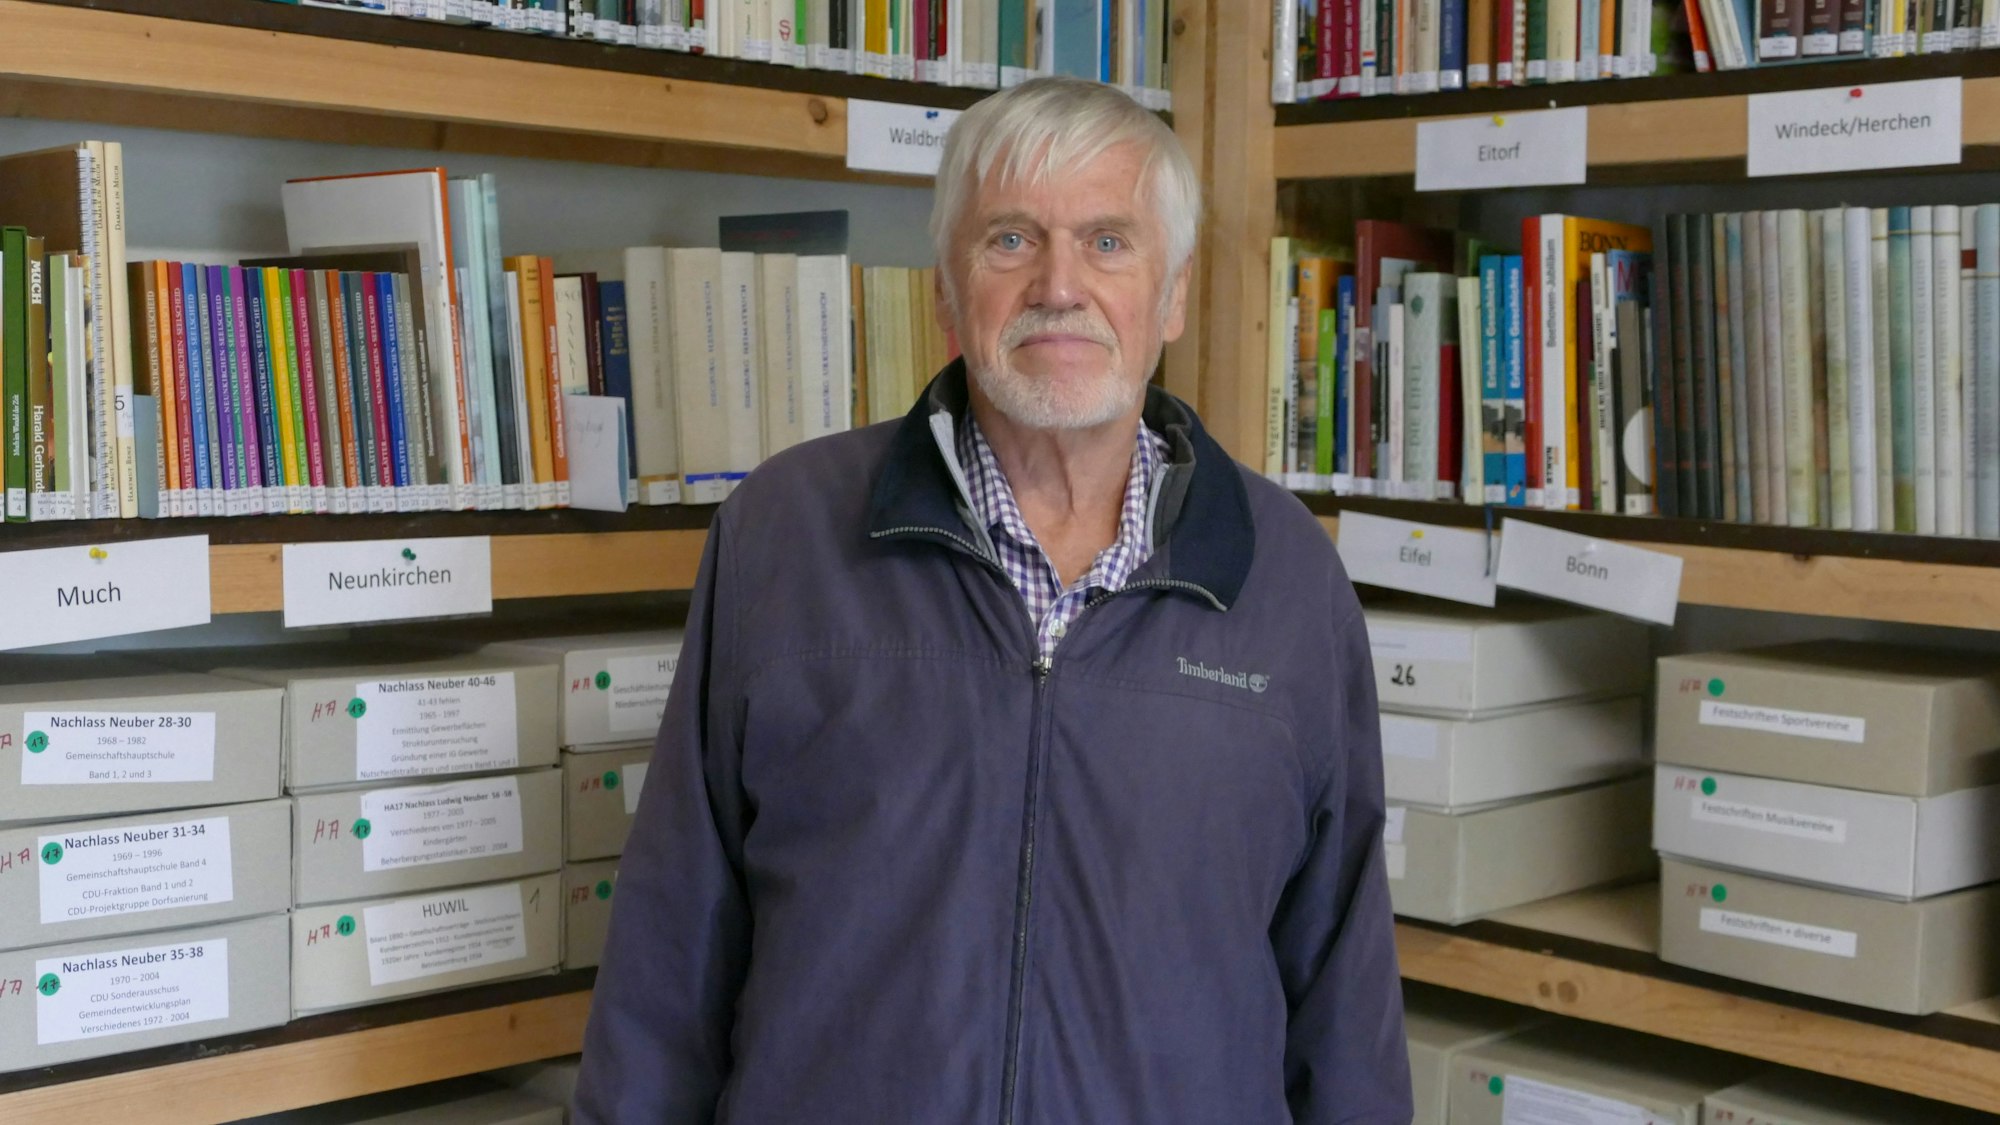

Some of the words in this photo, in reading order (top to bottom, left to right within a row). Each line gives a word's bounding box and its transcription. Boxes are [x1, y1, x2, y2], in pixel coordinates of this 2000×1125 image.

[1776, 112, 1932, 140] Windeck/Herchen
[1477, 142, 1522, 162] Eitorf
[115, 395, 125, 411] 5
[33, 404, 44, 443] Harald
[1400, 546, 1432, 567] Eifel
[1566, 556, 1610, 581] Bonn
[328, 567, 453, 591] Neunkirchen
[57, 582, 122, 608] Much
[657, 659, 677, 673] HU
[1176, 656, 1249, 690] Timberland
[1391, 664, 1416, 686] 26
[378, 681, 424, 694] Nachlass
[427, 678, 465, 690] Neuber
[468, 675, 496, 687] 40-46
[50, 716, 106, 729] Nachlass
[110, 716, 155, 729] Neuber
[158, 716, 192, 729] 28-30
[1713, 706, 1779, 722] Festschriften
[1782, 714, 1850, 731] Sportvereine
[97, 736, 117, 746] 1968
[127, 736, 147, 746] 1982
[392, 725, 429, 737] Ermittlung
[31, 736, 45, 748] 17
[401, 735, 478, 749] Strukturuntersuchung
[65, 751, 175, 761] Gemeinschaftshauptschule
[391, 752, 427, 763] Gründung
[89, 770, 111, 779] Band
[113, 770, 120, 781] 1,
[122, 770, 127, 779] 2
[129, 770, 145, 779] und
[147, 770, 152, 779] 3
[384, 803, 403, 812] HA17
[405, 799, 435, 810] Nachlass
[437, 796, 461, 807] Ludwig
[463, 793, 488, 803] Neuber
[1701, 802, 1764, 819] Festschriften
[1766, 813, 1834, 832] Musikvereine
[64, 832, 119, 850] Nachlass
[123, 828, 169, 844] Neuber
[172, 824, 206, 838] 31-34
[390, 825, 440, 838] Verschiedenes
[423, 834, 467, 848] Kindergärten
[112, 852, 133, 862] 1969
[142, 849, 163, 859] 1996
[66, 862, 178, 882] Gemeinschaftshauptschule
[179, 859, 198, 869] Band
[82, 885, 139, 900] CDU-Fraktion
[140, 882, 162, 893] Band
[171, 880, 187, 889] und
[188, 879, 194, 887] 2
[67, 898, 150, 918] CDU-Projektgruppe
[151, 891, 209, 908] Dorfsanierung
[422, 899, 469, 918] HUWIL
[1720, 915, 1783, 934] Festschriften
[1794, 929, 1832, 943] diverse
[62, 956, 118, 974] Nachlass
[121, 951, 167, 966] Neuber
[169, 947, 204, 960] 35-38
[110, 976, 131, 986] 1970
[140, 972, 160, 981] 2004
[90, 993, 109, 1003] CDU
[111, 984, 179, 1000] Sonderausschuss
[78, 998, 191, 1020] Gemeindeentwicklungsplan
[80, 1019, 141, 1034] Verschiedenes
[143, 1016, 163, 1025] 1972
[170, 1013, 190, 1022] 2004
